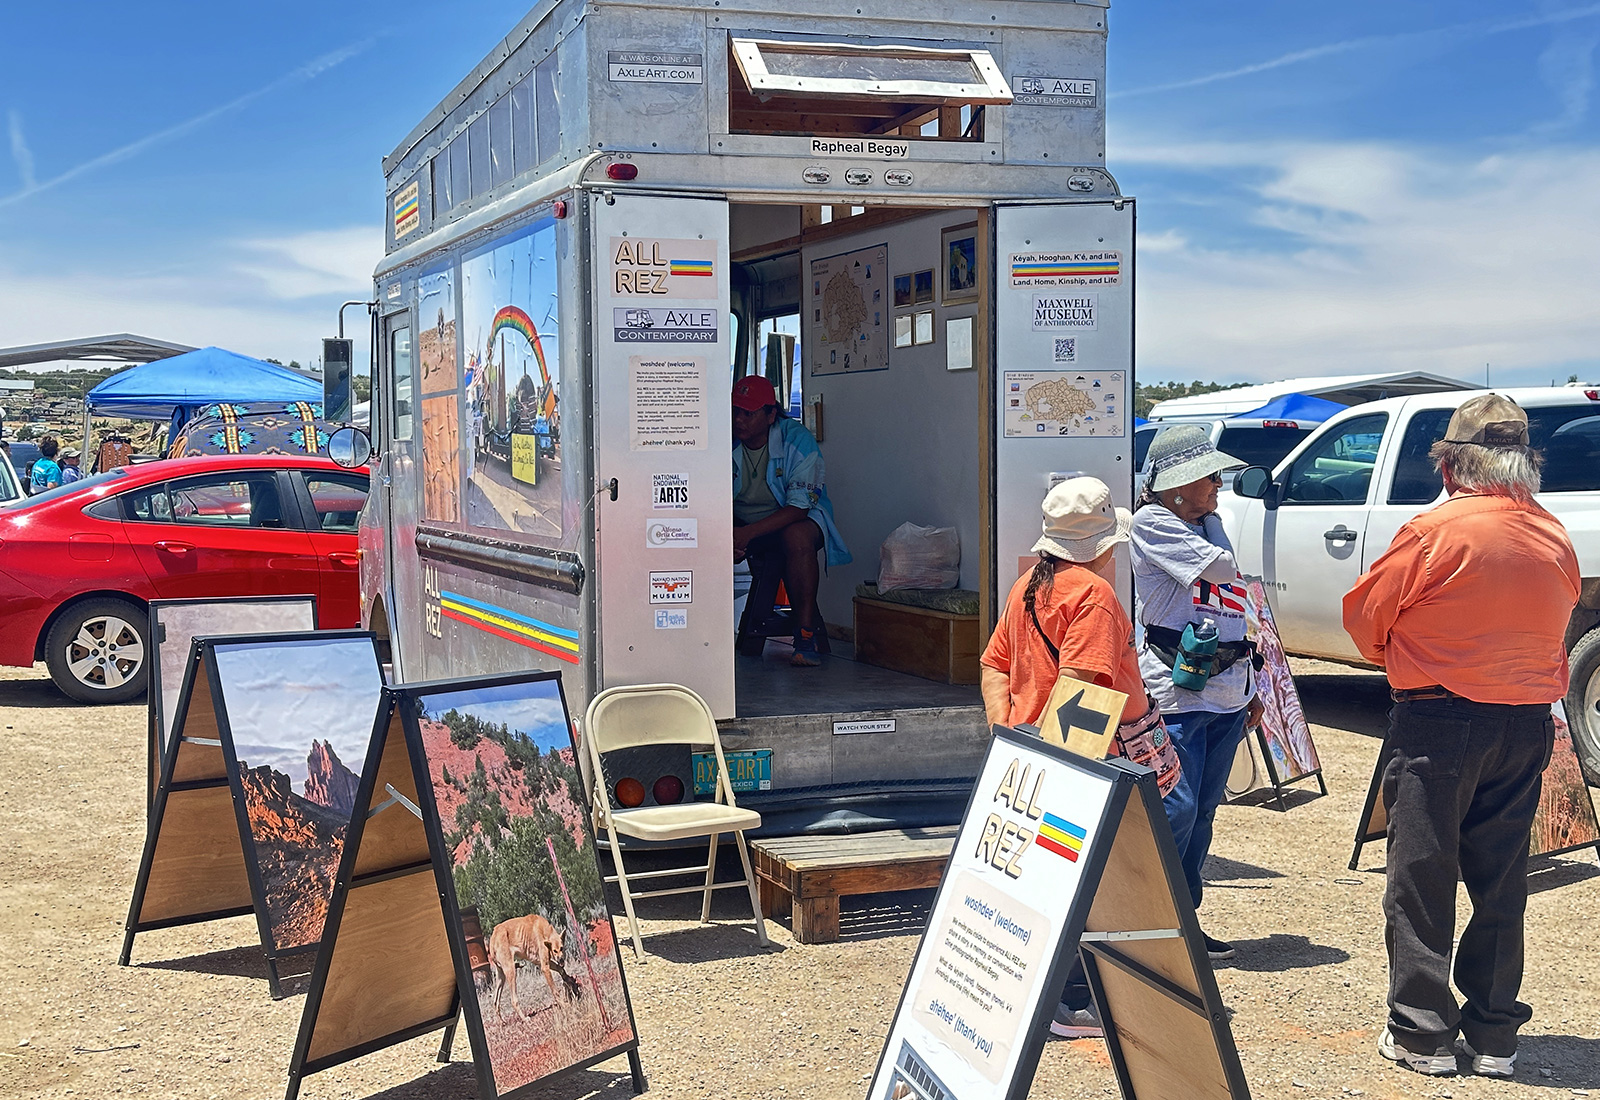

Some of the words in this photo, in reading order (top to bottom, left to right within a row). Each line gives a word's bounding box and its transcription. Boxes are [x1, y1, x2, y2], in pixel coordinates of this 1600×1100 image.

[812, 140, 863, 154] Rapheal
[868, 142, 907, 157] Begay
[615, 240, 668, 266] ALL
[616, 269, 668, 294] REZ
[1035, 309, 1092, 320] MUSEUM
[1038, 299, 1093, 308] MAXWELL
[659, 487, 688, 503] ARTS
[425, 565, 440, 599] ALL
[425, 602, 442, 639] REZ
[697, 758, 764, 782] AXEART
[993, 758, 1046, 821] ALL
[975, 812, 1034, 880] REZ
[964, 895, 997, 920] woshdee'
[994, 911, 1032, 946] (welcome)
[954, 1016, 977, 1043] (thank
[975, 1035, 994, 1058] you)
